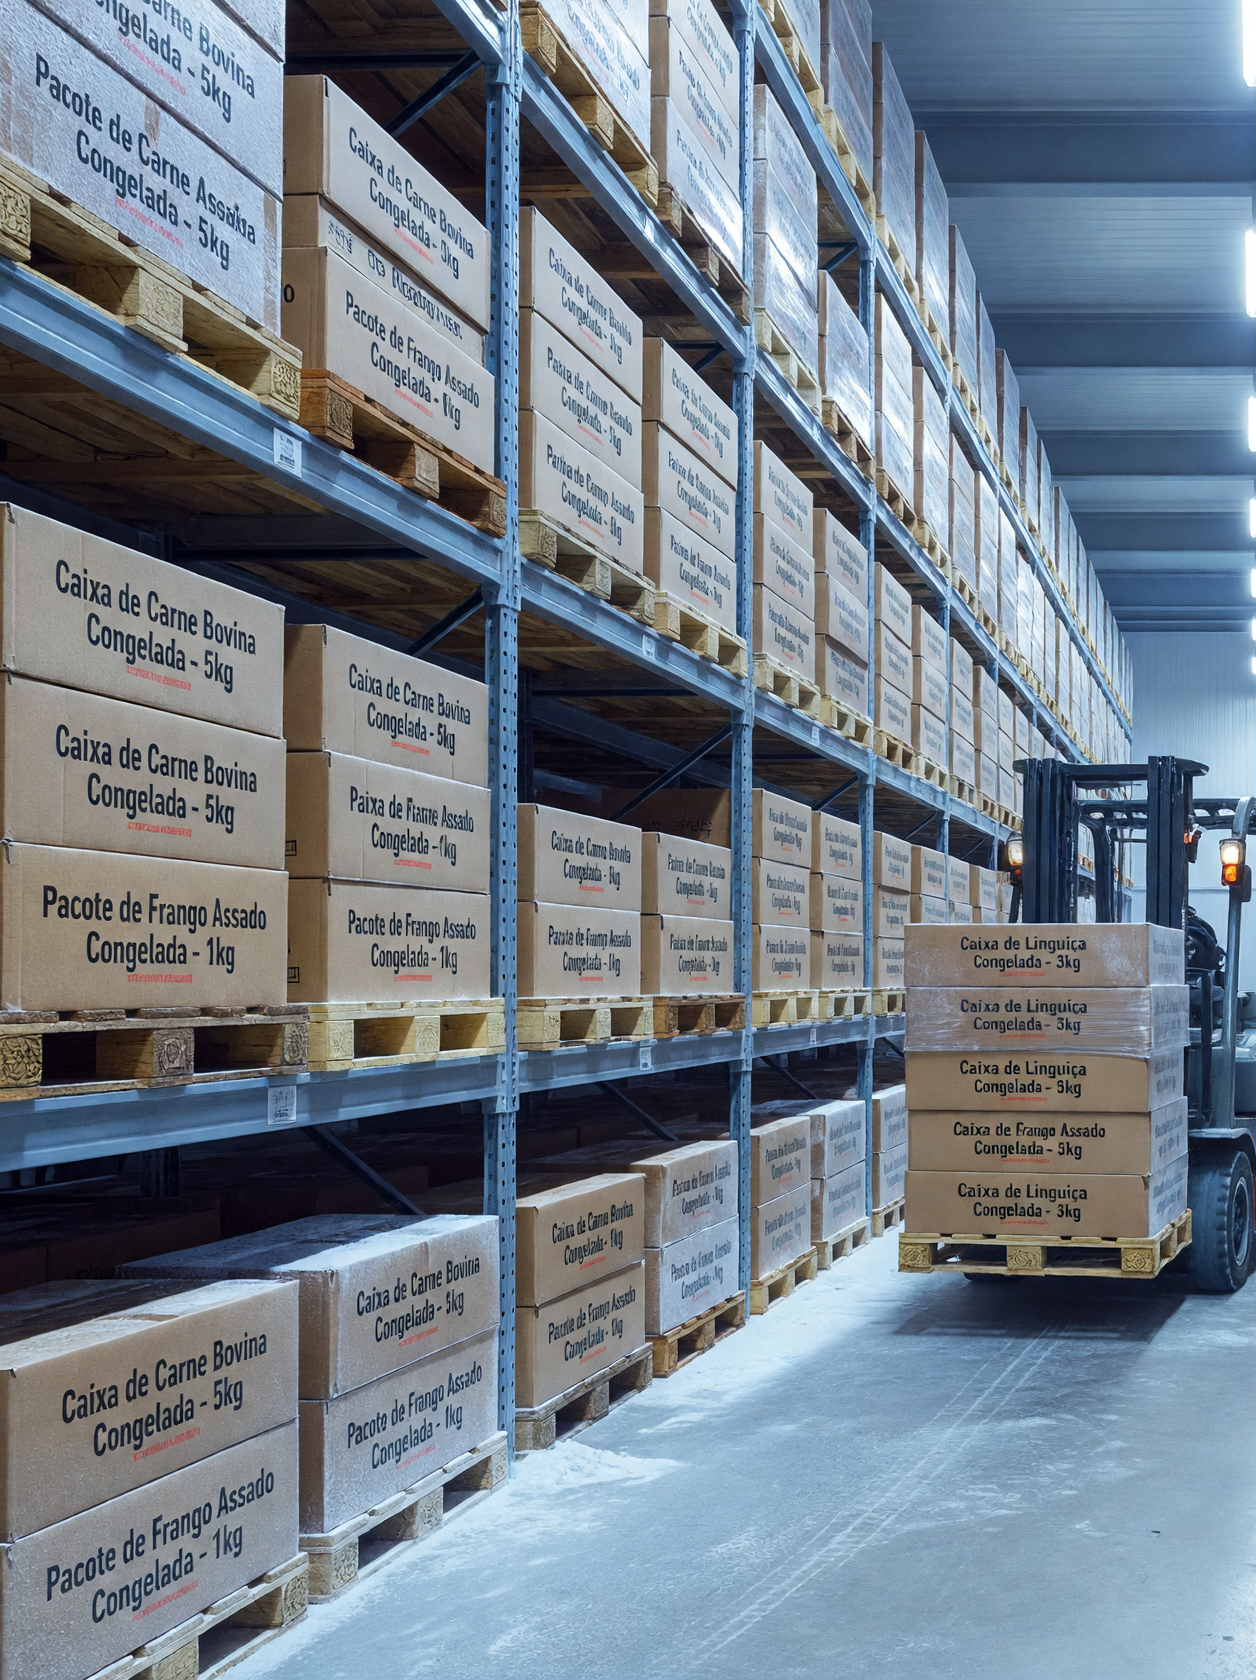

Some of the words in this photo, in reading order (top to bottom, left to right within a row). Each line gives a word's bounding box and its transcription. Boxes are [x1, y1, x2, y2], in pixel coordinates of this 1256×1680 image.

[94, 0, 181, 73] ngelada
[200, 62, 231, 124] 5kg
[142, 0, 193, 42] arne
[198, 22, 255, 99] Bovina
[35, 52, 102, 132] Pacote
[108, 112, 133, 152] de
[137, 132, 190, 196] Carne
[76, 129, 178, 227] Congelada
[198, 215, 229, 271] 5kg
[345, 289, 386, 342] Pacote
[389, 325, 403, 354] de
[55, 559, 112, 608] Caixa
[118, 582, 140, 617] de
[146, 590, 197, 636] Carne
[202, 609, 256, 655] Bovina
[86, 612, 186, 672] Congelada
[204, 649, 233, 694] 5kg
[348, 662, 382, 697] Caixa
[385, 676, 400, 702] de
[403, 681, 434, 713] Carne
[366, 701, 427, 742] Congelada
[436, 722, 455, 756] 5kg
[55, 723, 112, 766] Caixa
[118, 737, 142, 771] de
[147, 742, 198, 782] Carne
[203, 754, 257, 793] Bovina
[87, 772, 186, 820] Congelada
[204, 793, 234, 834] 5kg
[42, 884, 113, 921] Pacote
[119, 890, 142, 923] de
[148, 892, 207, 934] Frango
[211, 897, 266, 930] Assado
[348, 908, 385, 936] Pacote
[388, 911, 402, 936] de
[405, 912, 440, 944] Frango
[86, 930, 187, 973] Congelada
[206, 936, 235, 974] 1kg
[370, 942, 429, 975] Congelada
[439, 945, 457, 975] 1kg
[960, 936, 998, 950] Caixa
[1003, 935, 1020, 950] de
[1025, 935, 1087, 954] Linguiça
[973, 953, 1041, 972] Congelada
[1056, 954, 1080, 973] 3kg
[960, 999, 1000, 1013] Caixa
[1004, 998, 1021, 1012] de
[959, 1059, 999, 1074] Caixa
[1004, 1060, 1020, 1075] de
[1025, 1060, 1086, 1079] Linguiça
[953, 1120, 990, 1136] Caixa
[995, 1122, 1011, 1136] de
[1059, 1122, 1106, 1138] Assado
[974, 1139, 1043, 1158] Congelada
[957, 1182, 999, 1198] Caixa
[1004, 1182, 1021, 1198] de
[1026, 1183, 1087, 1202] Linguiça
[973, 1201, 1042, 1220] Congelada
[1056, 1203, 1081, 1222] 3kg
[356, 1286, 390, 1316] Caixa
[393, 1276, 407, 1303] de
[61, 1382, 118, 1424] Caixa
[125, 1367, 149, 1402] de
[154, 1354, 207, 1392] Carne
[212, 1331, 267, 1372] Bovina
[93, 1392, 194, 1456] Congelada
[213, 1376, 243, 1411] 5kg
[46, 1546, 116, 1602] Pacote
[122, 1527, 145, 1564] de
[151, 1501, 212, 1550] Frango
[216, 1467, 274, 1518] Assado
[91, 1547, 194, 1623] Congelada
[212, 1523, 243, 1559] 1kg
